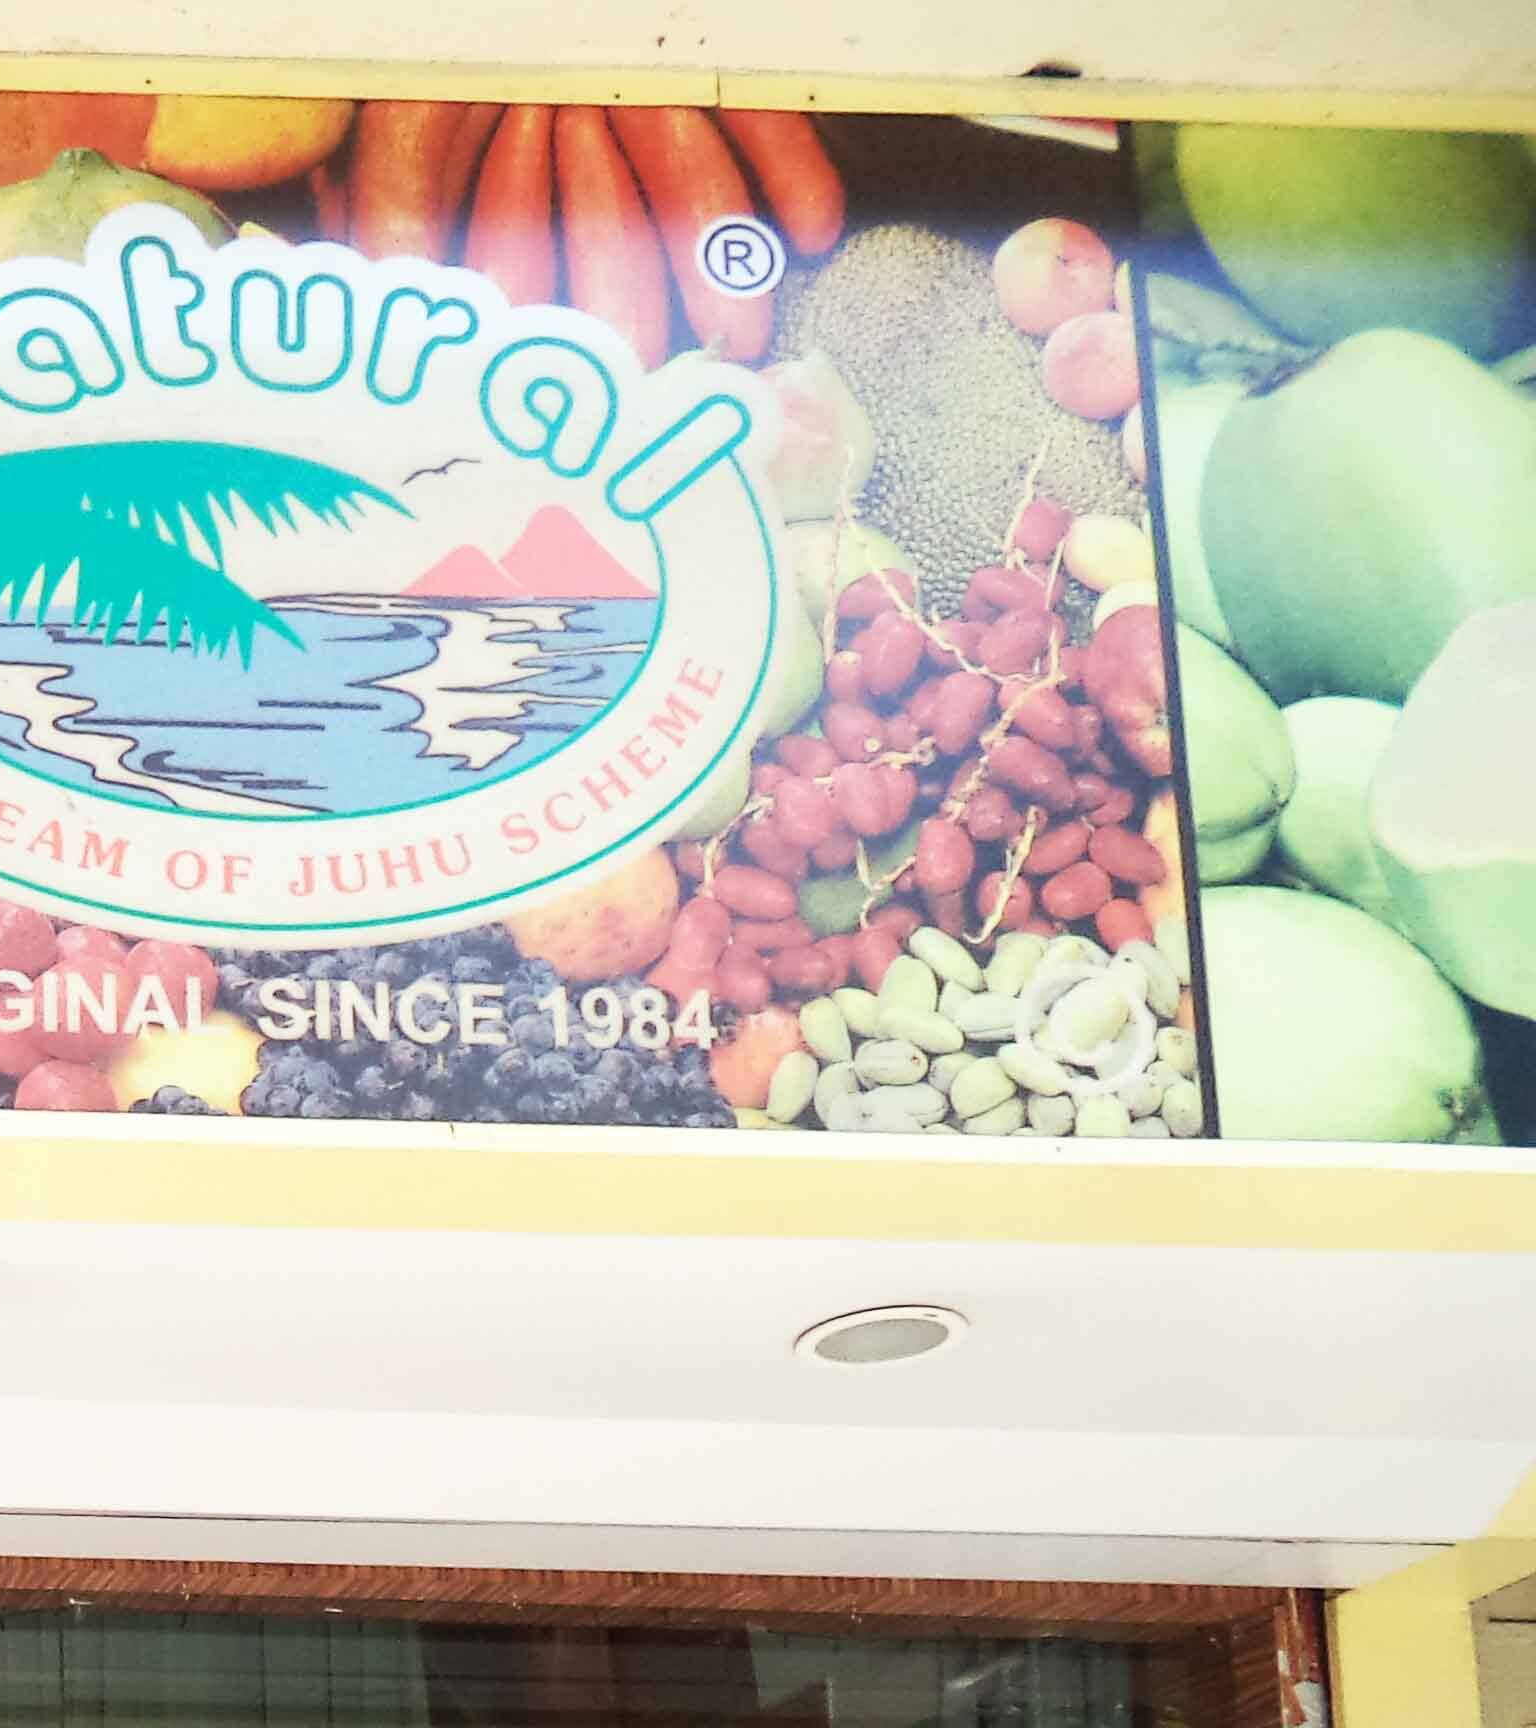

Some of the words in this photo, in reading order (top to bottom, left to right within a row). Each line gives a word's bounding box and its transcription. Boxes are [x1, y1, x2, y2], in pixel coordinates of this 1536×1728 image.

[164, 848, 255, 896] OF
[288, 834, 476, 898] JUHU
[499, 656, 725, 856] SCHEME
[256, 978, 510, 1048] SINCE
[540, 982, 722, 1052] 1984
